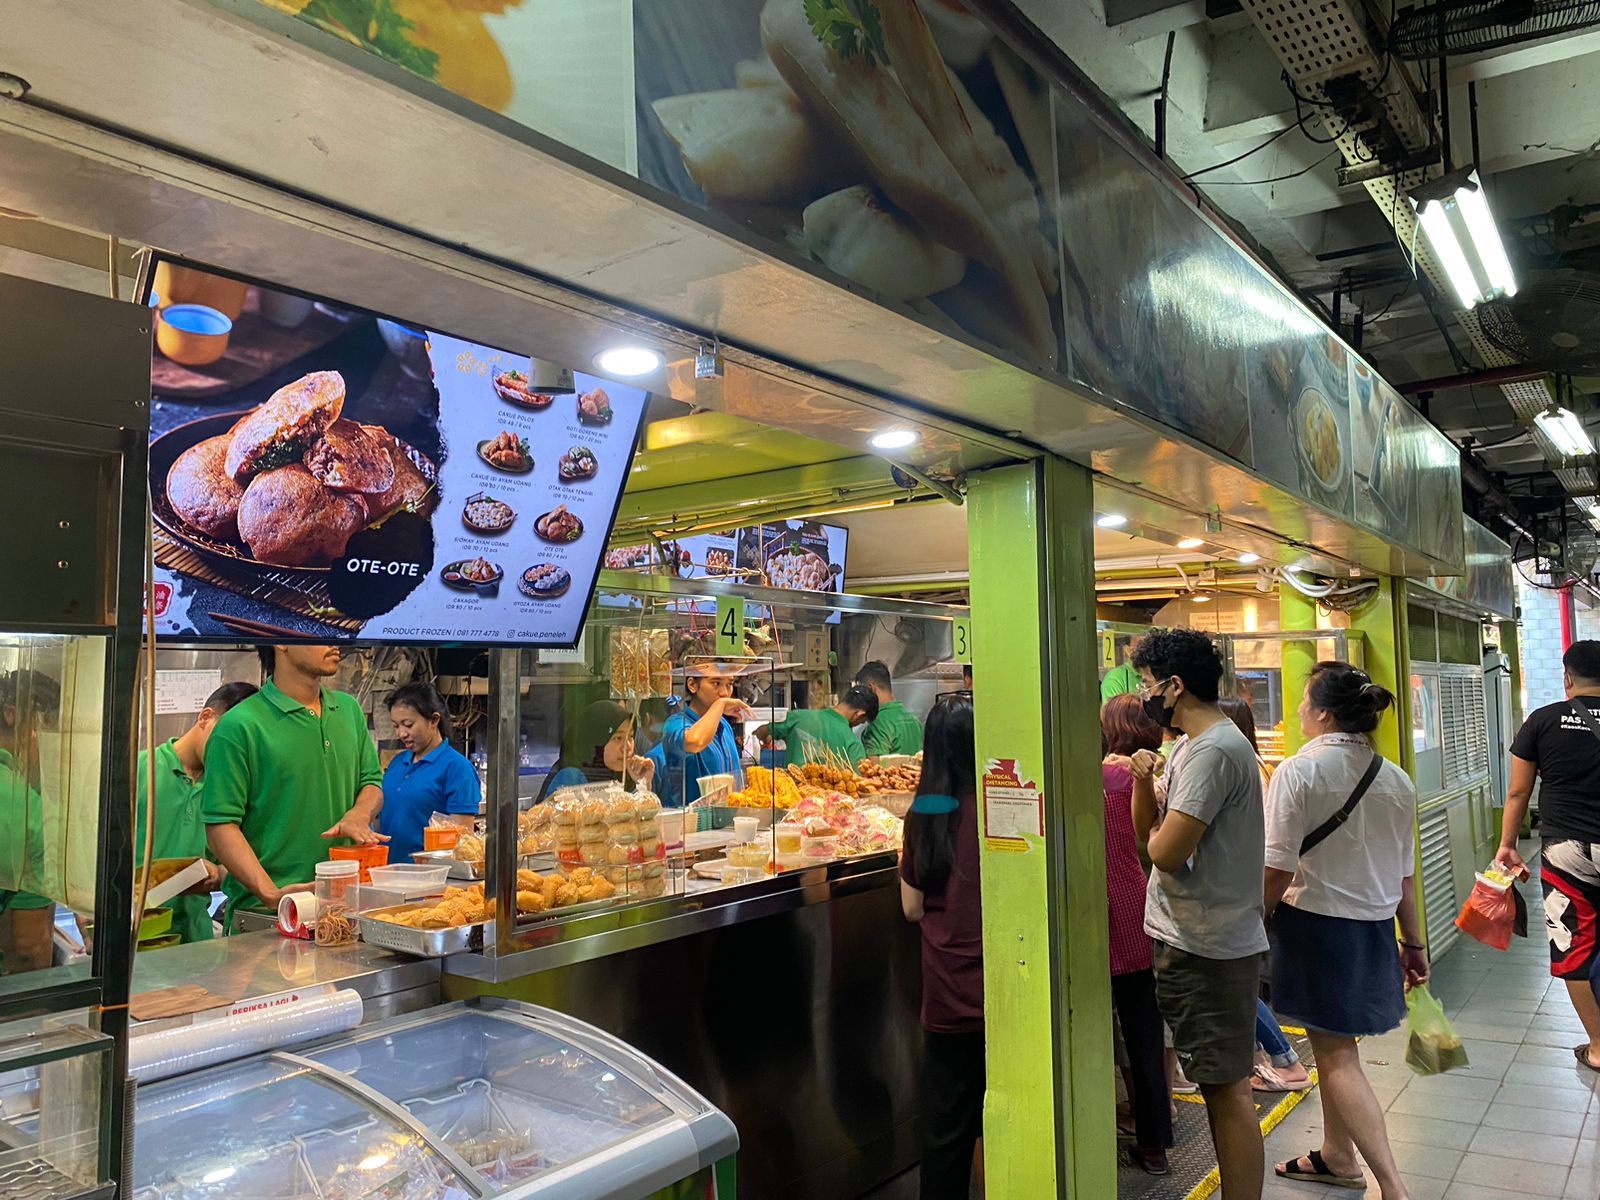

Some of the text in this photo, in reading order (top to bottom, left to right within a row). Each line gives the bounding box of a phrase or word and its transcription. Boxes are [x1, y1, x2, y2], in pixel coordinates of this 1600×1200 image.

[517, 415, 534, 423] POLOS
[471, 473, 489, 481] CAKUE
[514, 479, 531, 487] UDANG
[347, 558, 420, 576] OTE-OTE
[382, 627, 420, 635] PRODUCT
[517, 629, 566, 638] cakue.peneleh
[721, 608, 738, 645] 4
[958, 626, 966, 655] 3
[1106, 637, 1112, 660] 2
